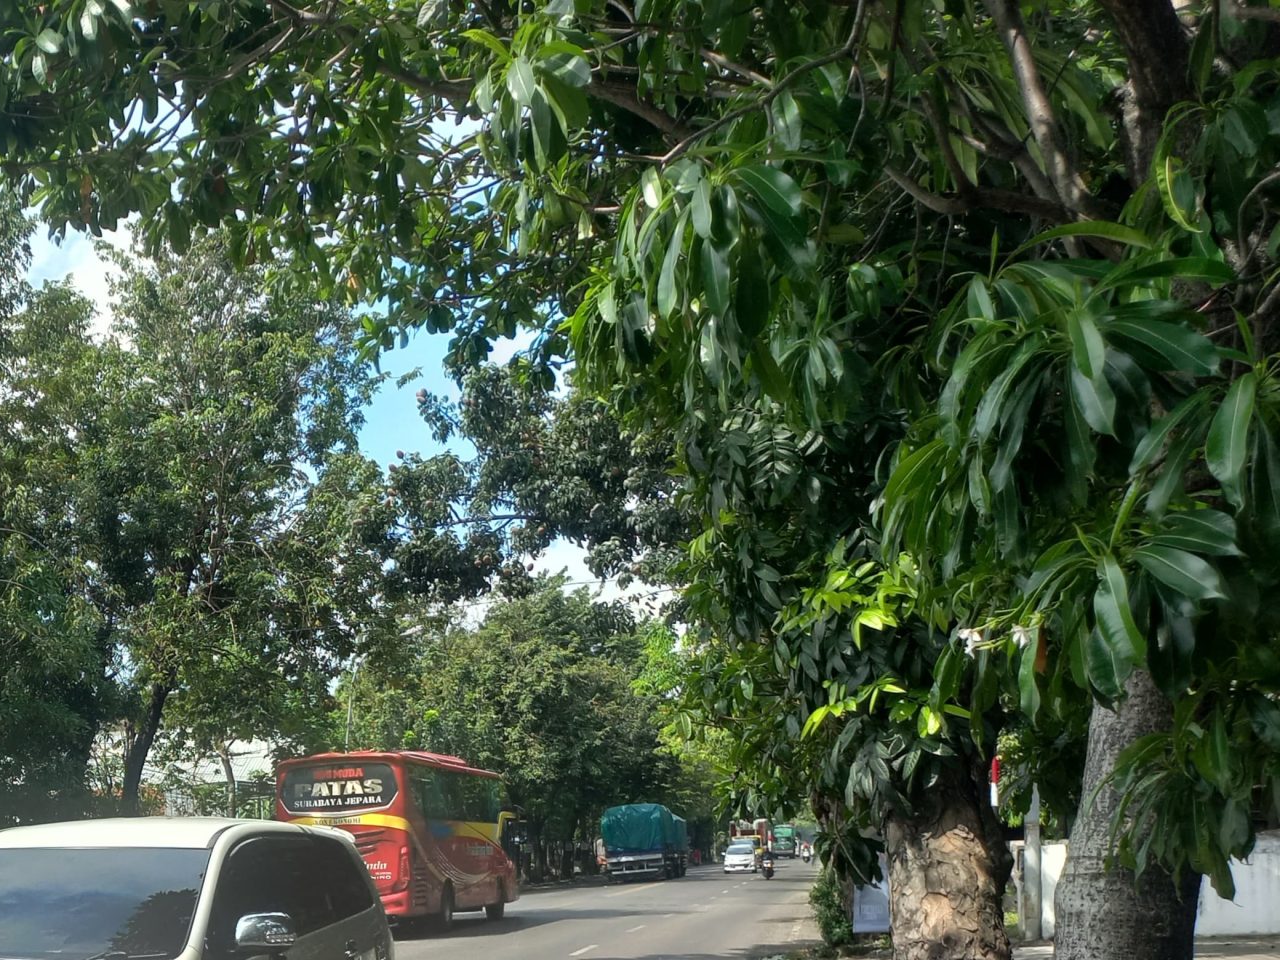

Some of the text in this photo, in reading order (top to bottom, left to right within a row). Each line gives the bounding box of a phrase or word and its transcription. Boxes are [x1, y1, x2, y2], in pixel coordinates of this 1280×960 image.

[294, 779, 382, 797] PATAS
[294, 796, 382, 808] SURABAYA JEPARA
